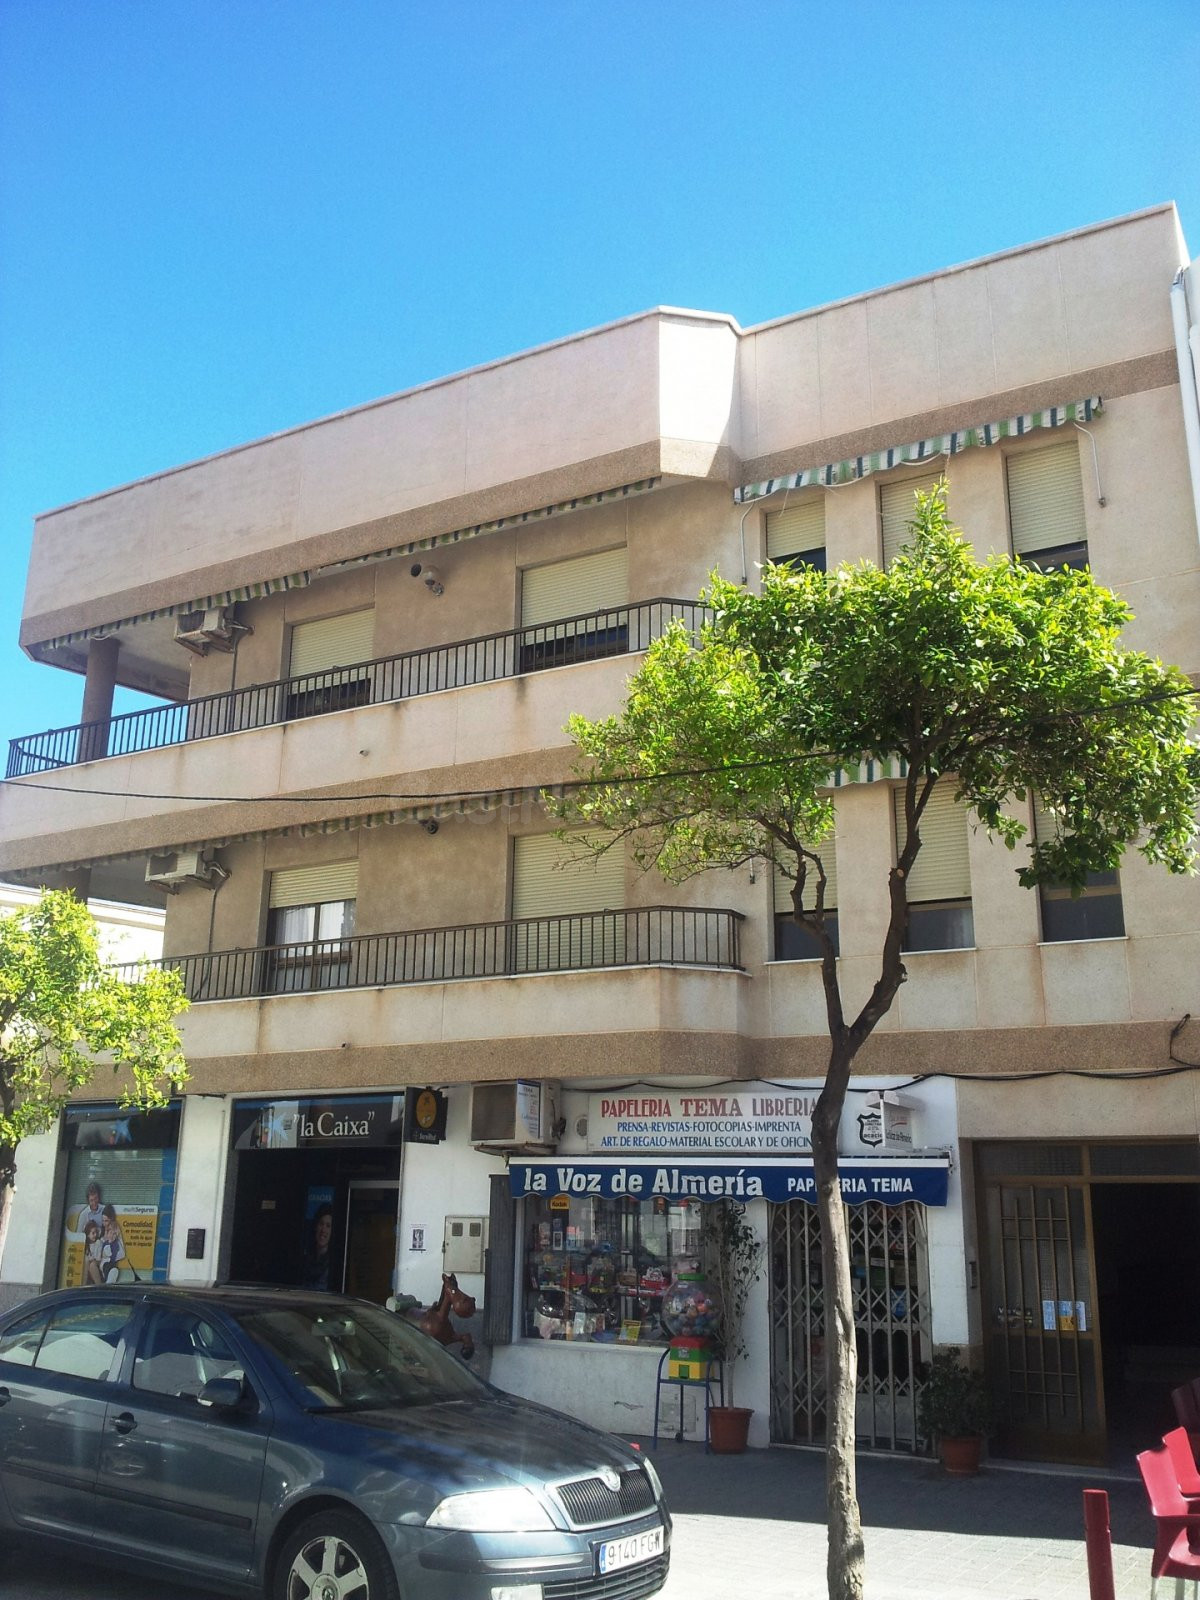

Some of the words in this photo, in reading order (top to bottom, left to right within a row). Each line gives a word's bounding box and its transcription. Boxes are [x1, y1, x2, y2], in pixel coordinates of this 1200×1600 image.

[601, 1099, 672, 1118] PAPELERIA
[680, 1098, 744, 1117] TEMA
[752, 1097, 818, 1116] LIBRERIA
[601, 1136, 619, 1147] ART.
[620, 1136, 632, 1147] DE
[715, 1136, 756, 1148] ESCOLAR
[757, 1137, 765, 1147] Y
[766, 1137, 779, 1147] DE
[781, 1136, 814, 1147] OFICIN
[524, 1168, 547, 1191] la
[557, 1168, 601, 1192] Voz
[611, 1168, 643, 1193] de
[652, 1168, 763, 1196] Almería
[871, 1178, 914, 1193] TEMA
[608, 1538, 637, 1566] 9140
[640, 1531, 662, 1554] FGW
